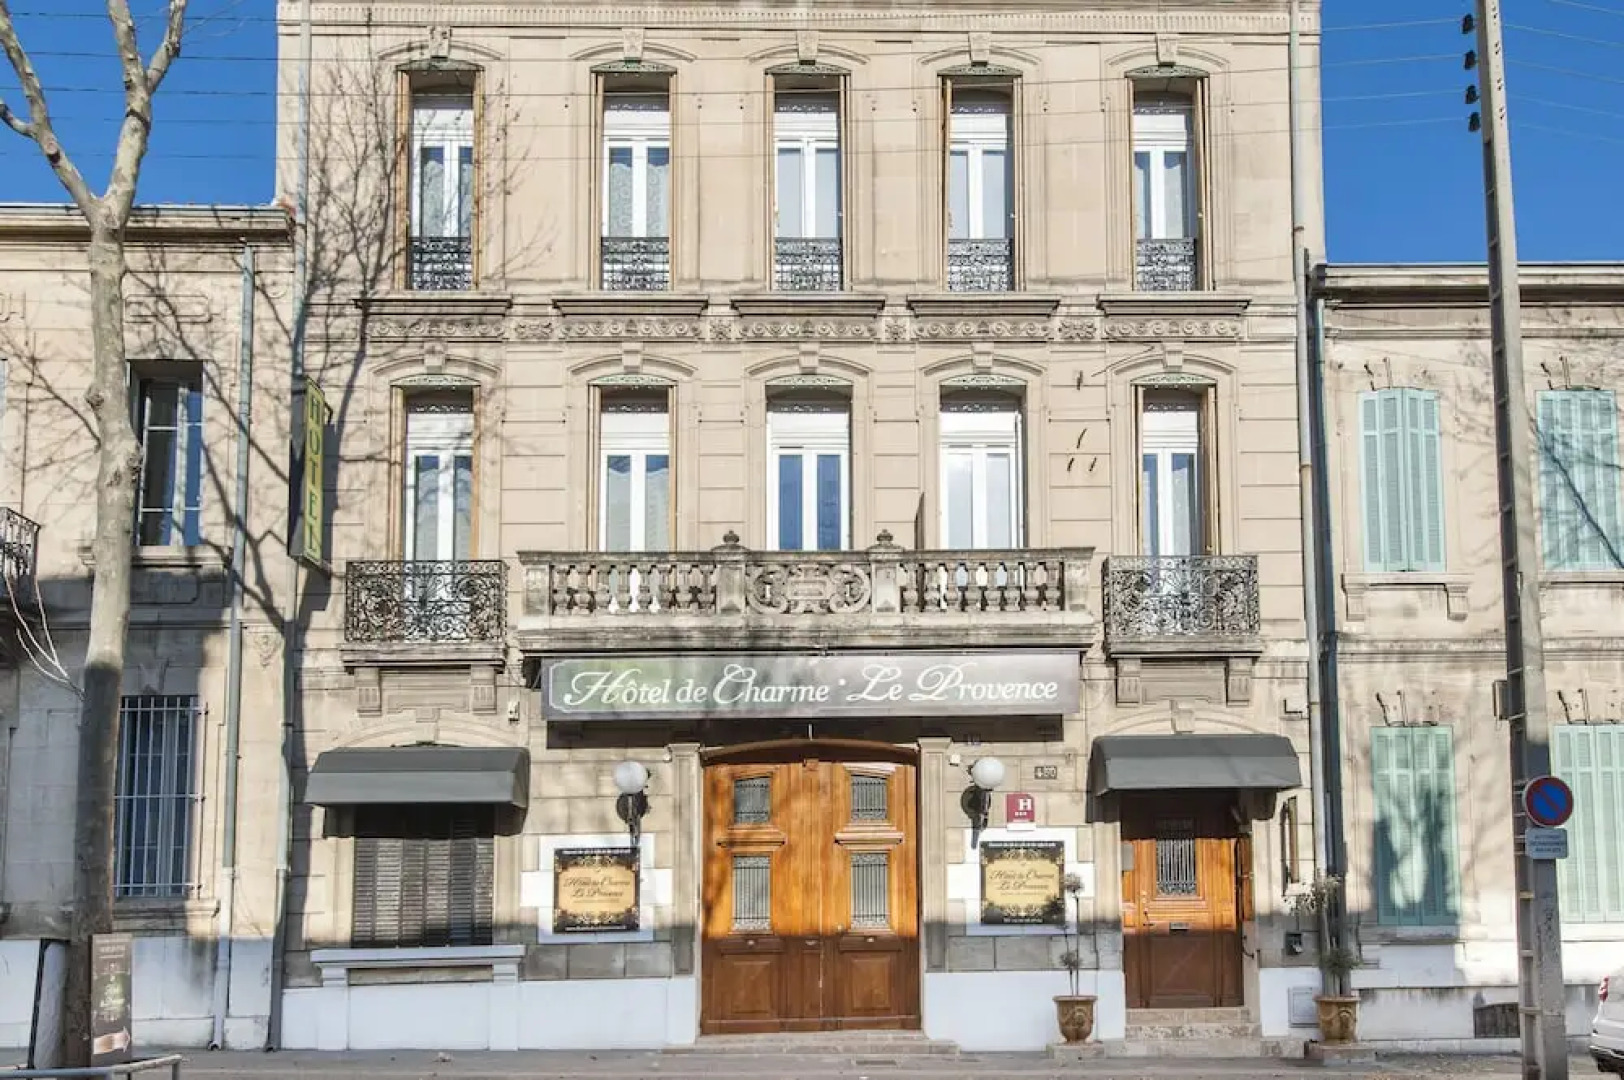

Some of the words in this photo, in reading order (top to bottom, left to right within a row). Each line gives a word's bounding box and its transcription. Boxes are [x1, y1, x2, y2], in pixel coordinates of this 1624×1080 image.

[308, 394, 322, 553] HOTEL
[563, 668, 671, 706] Hôtel
[675, 679, 707, 703] de
[713, 664, 829, 704] Charme
[846, 664, 904, 701] Le
[908, 662, 1058, 701] Provence
[1019, 798, 1032, 811] H
